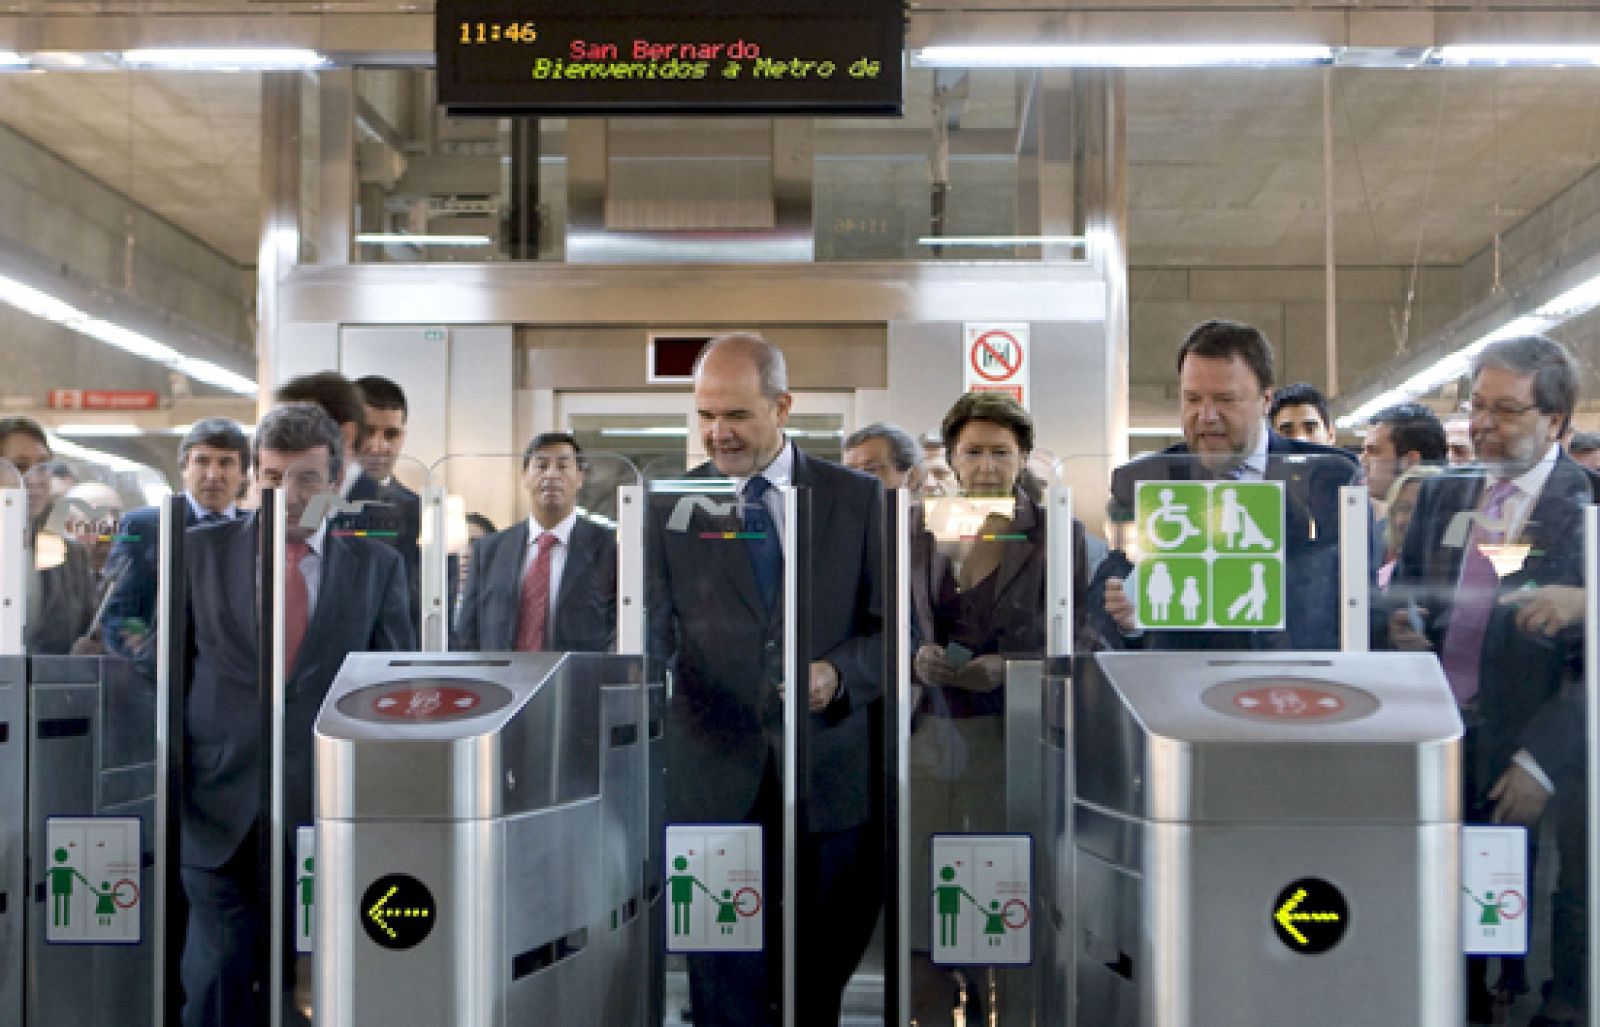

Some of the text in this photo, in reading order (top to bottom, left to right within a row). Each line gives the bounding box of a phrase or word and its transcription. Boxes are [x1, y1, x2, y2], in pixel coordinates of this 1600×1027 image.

[458, 22, 537, 43] 11:46
[569, 38, 760, 59] San Bernardo
[532, 58, 881, 79] Bienvenidos a Metro de
